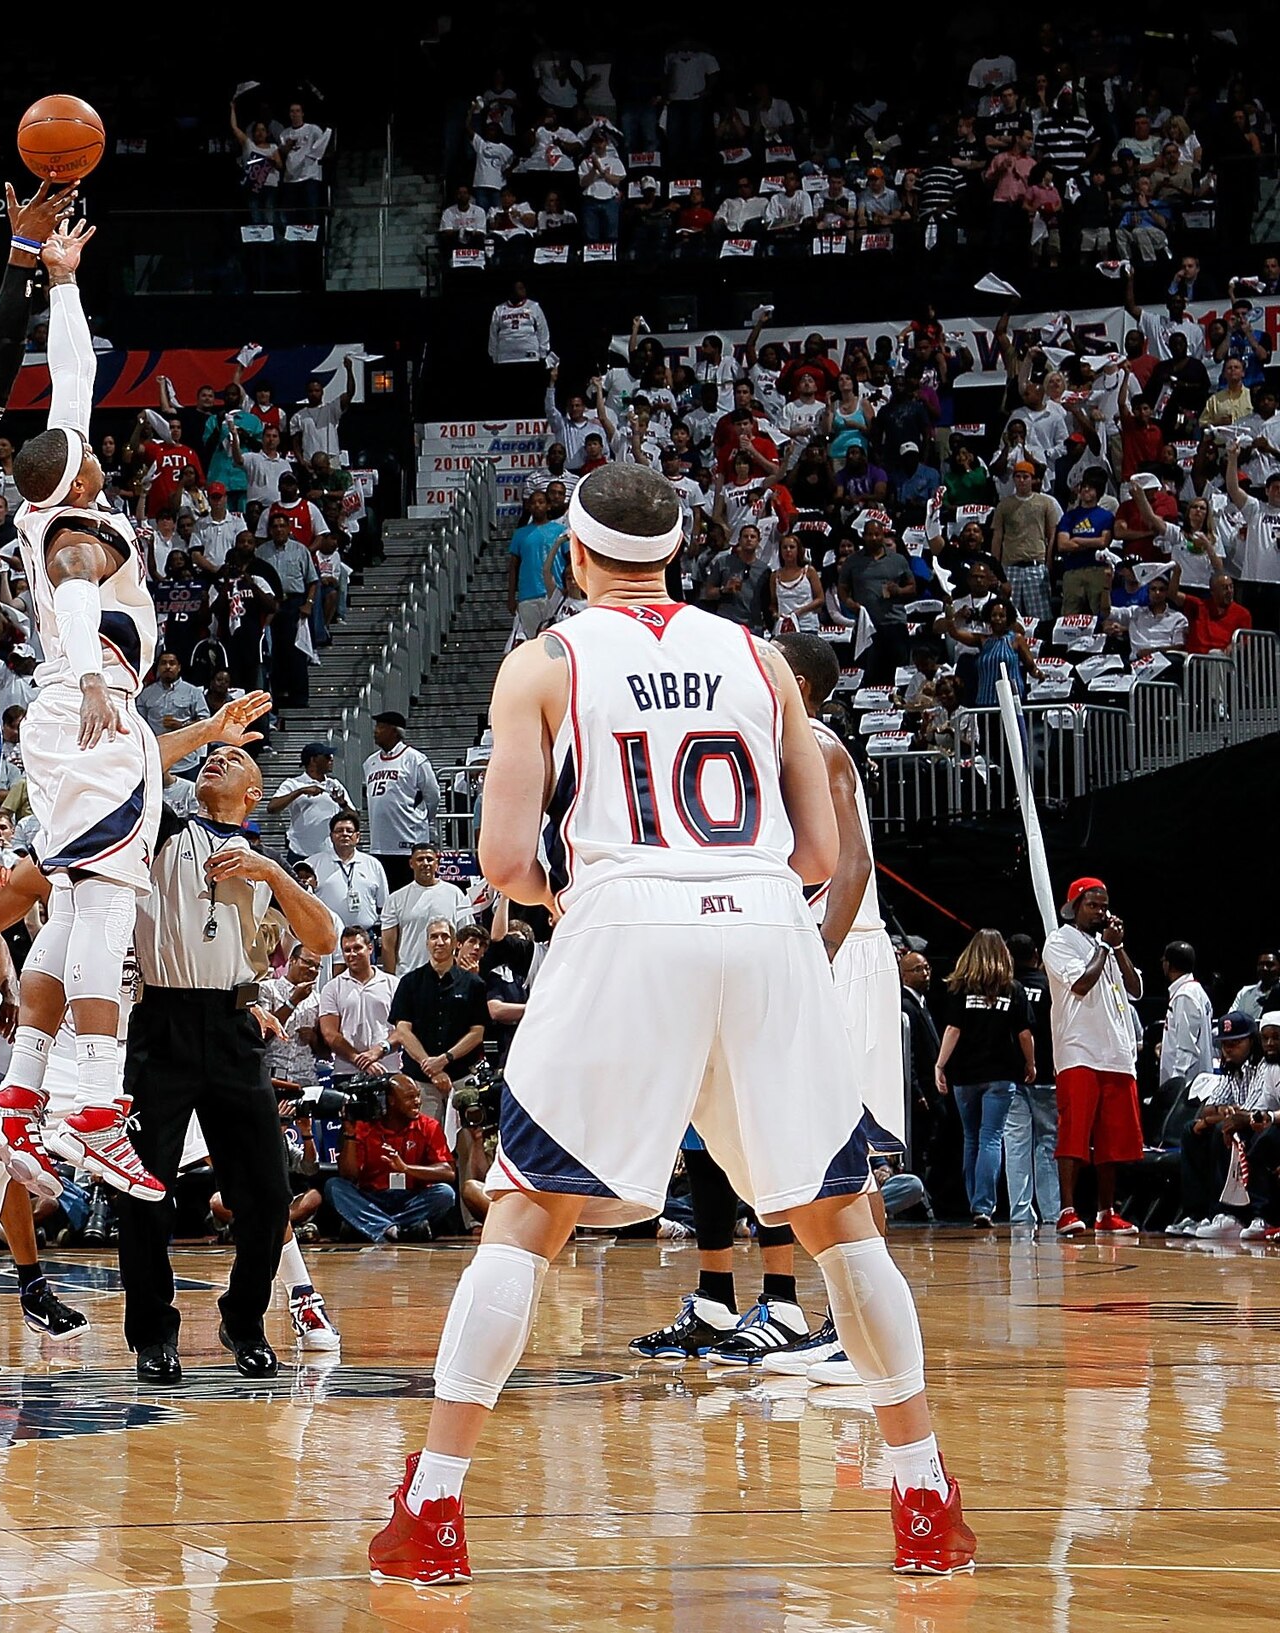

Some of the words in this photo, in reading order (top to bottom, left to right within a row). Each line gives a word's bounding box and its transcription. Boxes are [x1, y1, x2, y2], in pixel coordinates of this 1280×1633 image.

[763, 384, 773, 395] 2
[440, 424, 476, 437] 2010
[488, 439, 545, 454] Aaron's
[434, 459, 471, 473] 2010
[172, 469, 181, 481] 2
[736, 497, 748, 508] 10
[169, 590, 192, 601] GO
[156, 601, 202, 613] HAWKS
[174, 612, 189, 622] 15
[626, 673, 723, 711] BIBBY
[369, 769, 399, 782] HAWKS
[381, 781, 397, 797] 15
[612, 730, 762, 848] 10
[437, 863, 462, 877] GO
[700, 894, 743, 915] ATL
